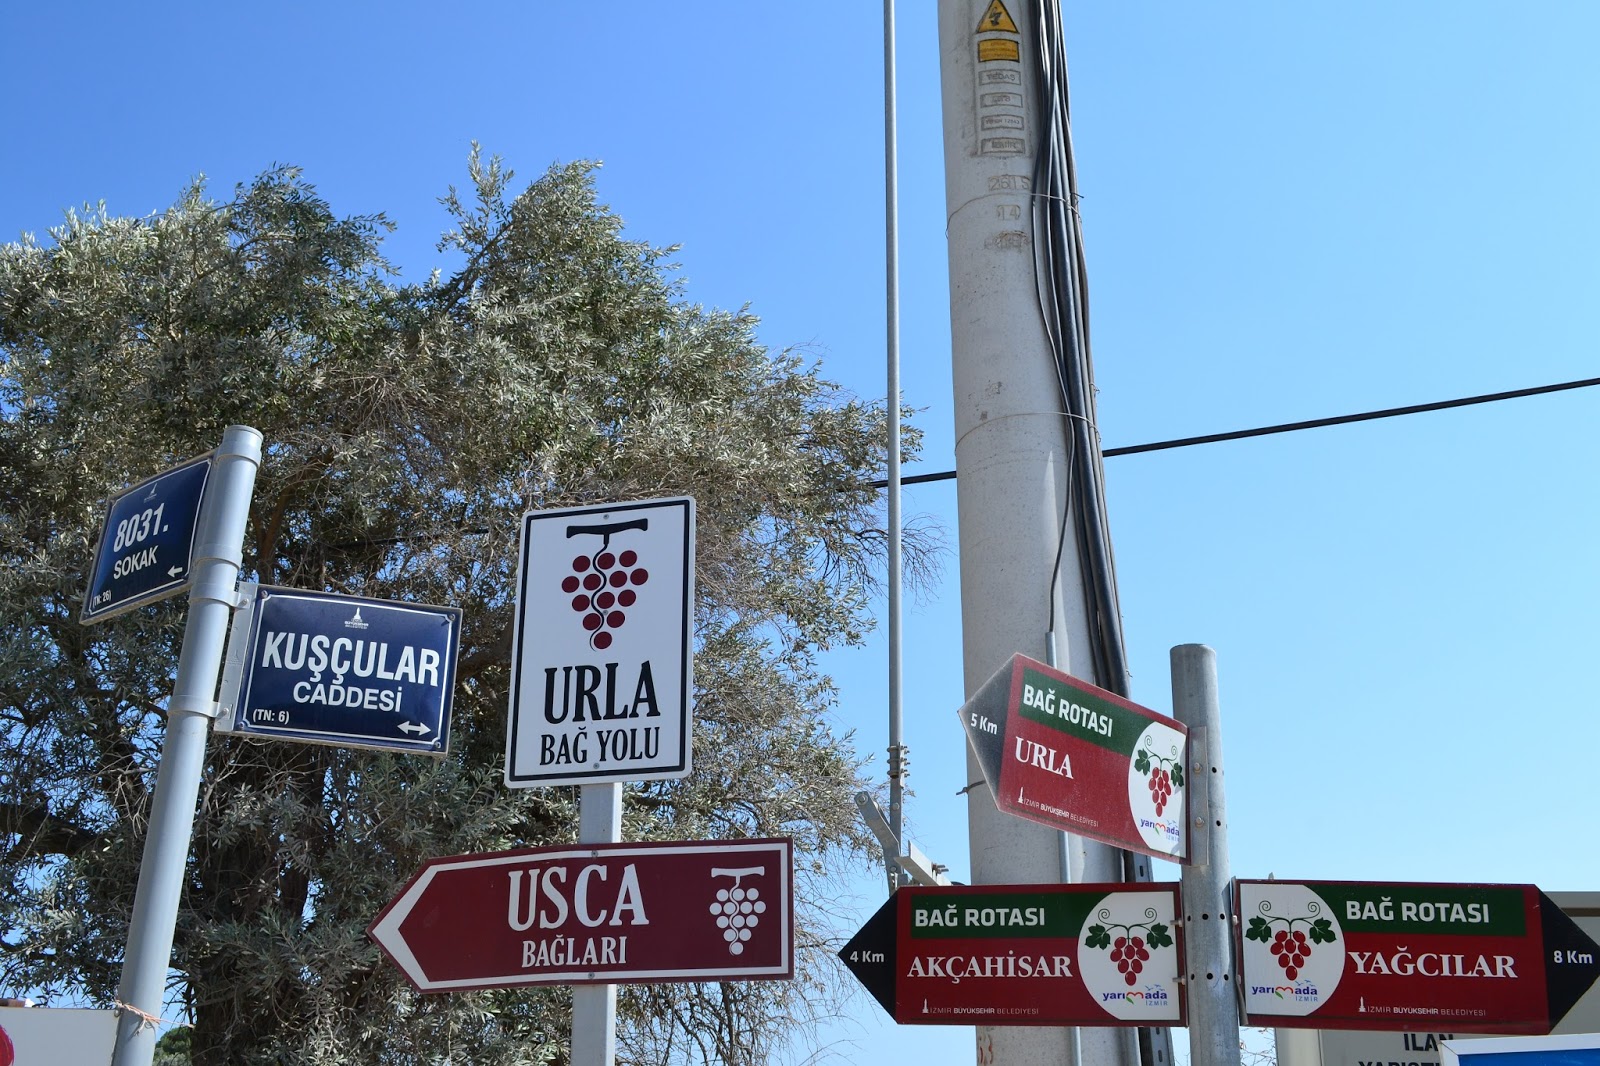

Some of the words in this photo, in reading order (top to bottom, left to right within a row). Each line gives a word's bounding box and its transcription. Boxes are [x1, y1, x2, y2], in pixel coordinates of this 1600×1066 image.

[113, 502, 169, 553] 8031.
[113, 545, 159, 580] SOKAK
[261, 631, 440, 687] KUŞÇULAR
[293, 681, 403, 713] CADDESİ
[544, 660, 661, 725] URLA
[252, 708, 275, 722] (TN:
[278, 710, 290, 725] 6)
[970, 712, 978, 728] 5
[979, 714, 998, 735] Km
[1023, 684, 1056, 715] BAĞ
[1058, 698, 1113, 738] ROTASI
[539, 726, 588, 766] BAĞ
[596, 726, 660, 762] YOLU
[1015, 736, 1074, 780] URLA
[508, 863, 650, 932] USCA
[1345, 896, 1394, 921] BAĞ
[1401, 901, 1489, 924] ROTASI
[915, 904, 958, 927] BAĞ
[965, 907, 1045, 927] ROTASI
[521, 934, 628, 968] BAĞLARI
[849, 950, 860, 963] 4
[862, 951, 885, 963] Km
[906, 949, 1073, 984] AKÇAHİSAR
[1347, 945, 1519, 979] YAĞCILAR
[1553, 950, 1563, 964] 8
[1567, 950, 1593, 965] Km
